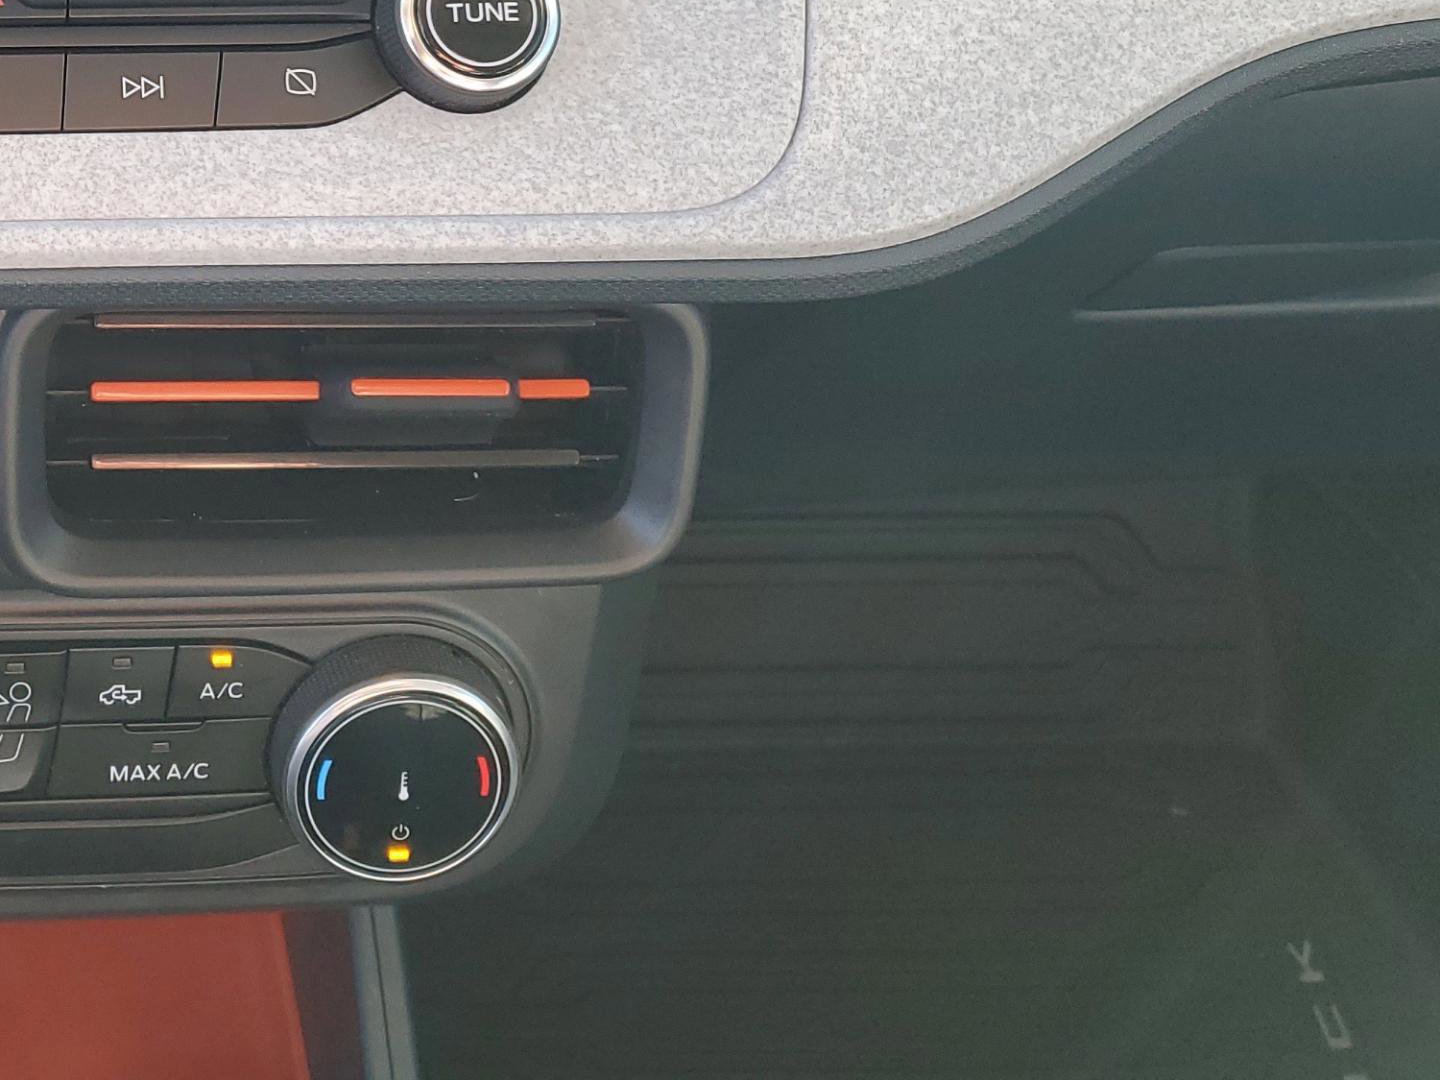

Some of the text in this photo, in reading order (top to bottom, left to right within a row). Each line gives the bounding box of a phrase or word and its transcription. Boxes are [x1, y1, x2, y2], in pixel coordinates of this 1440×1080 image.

[445, 1, 521, 24] TUNE
[199, 682, 244, 700] A/C
[109, 761, 210, 783] MAX A/C
